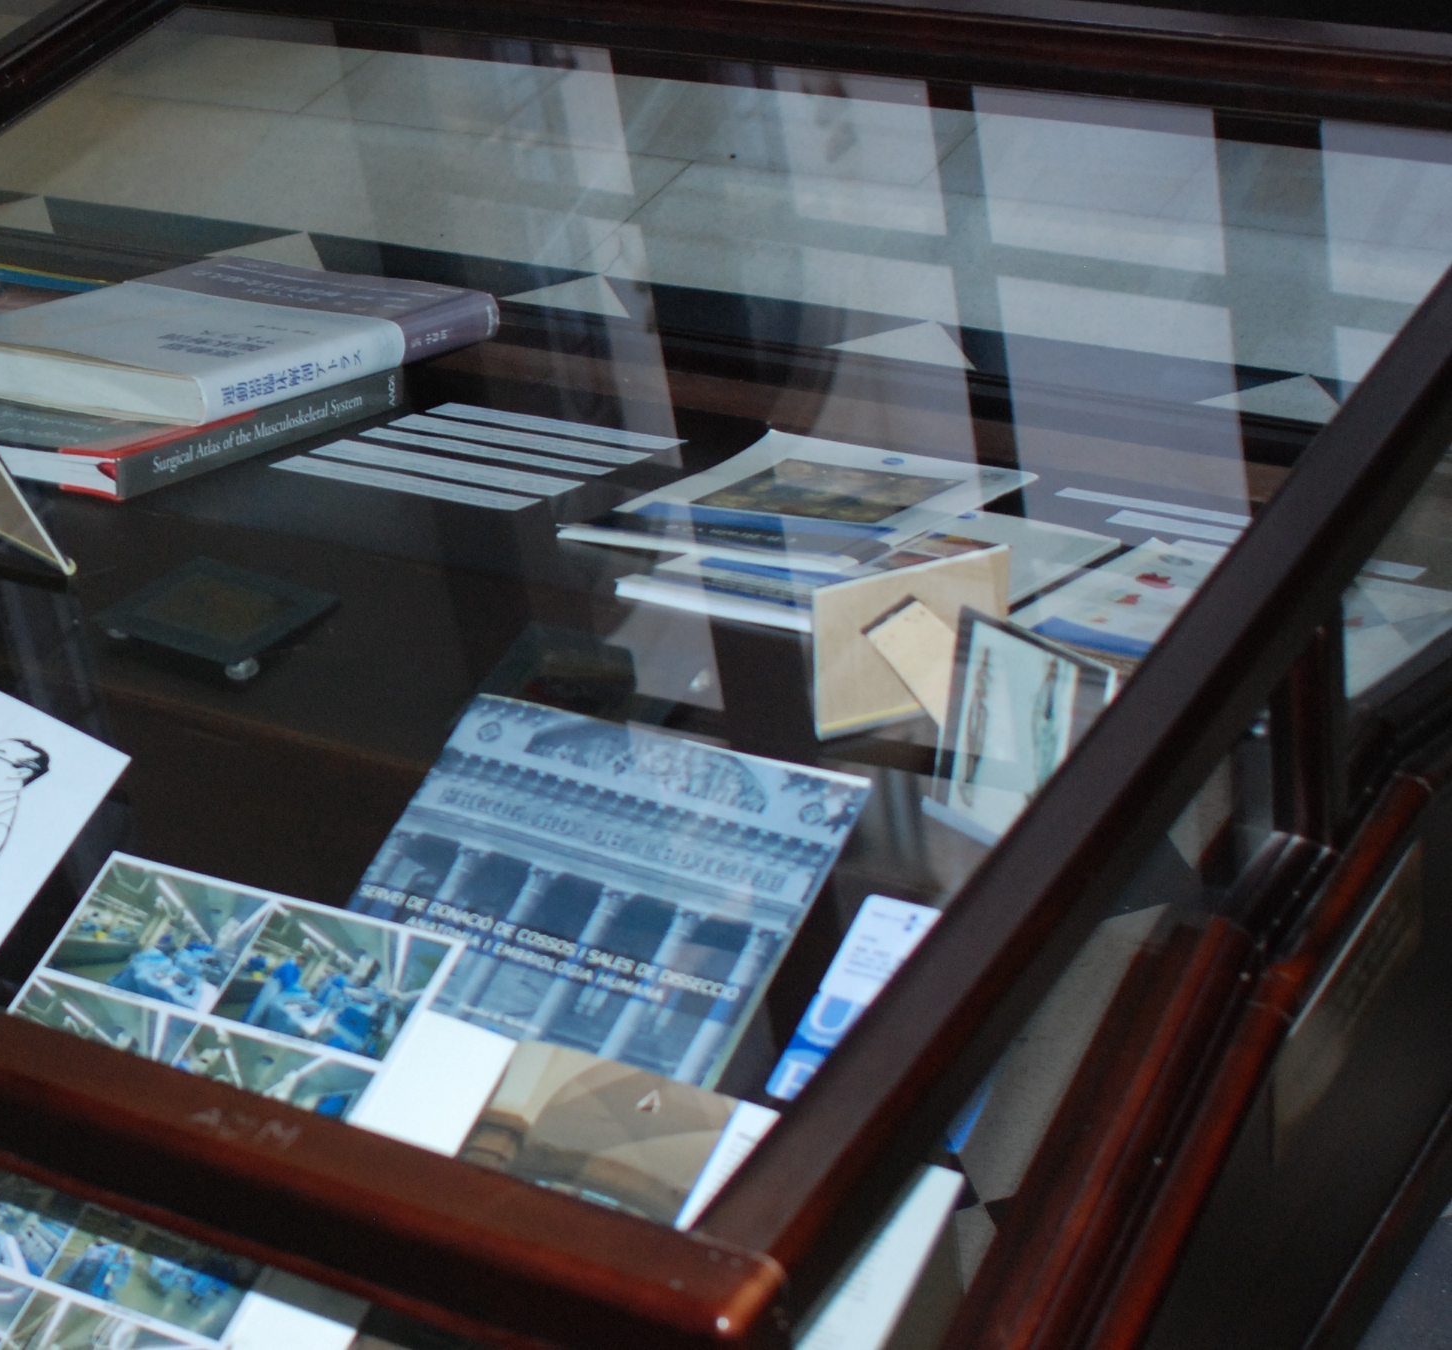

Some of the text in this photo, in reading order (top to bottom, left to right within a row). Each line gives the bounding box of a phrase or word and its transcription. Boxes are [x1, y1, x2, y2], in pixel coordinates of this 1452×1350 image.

[152, 394, 363, 474] Surgical Atlas of the Musculoskeletal System
[358, 884, 406, 906] SERVEI
[405, 895, 428, 912] DE
[427, 901, 493, 931] DONACIÓ
[493, 921, 517, 938] DE
[516, 929, 577, 959] COSSOS
[585, 948, 635, 974] SALES
[634, 962, 658, 980] DE
[492, 942, 594, 983] EMBRIOLOGIA
[597, 970, 664, 1002] HUMANA
